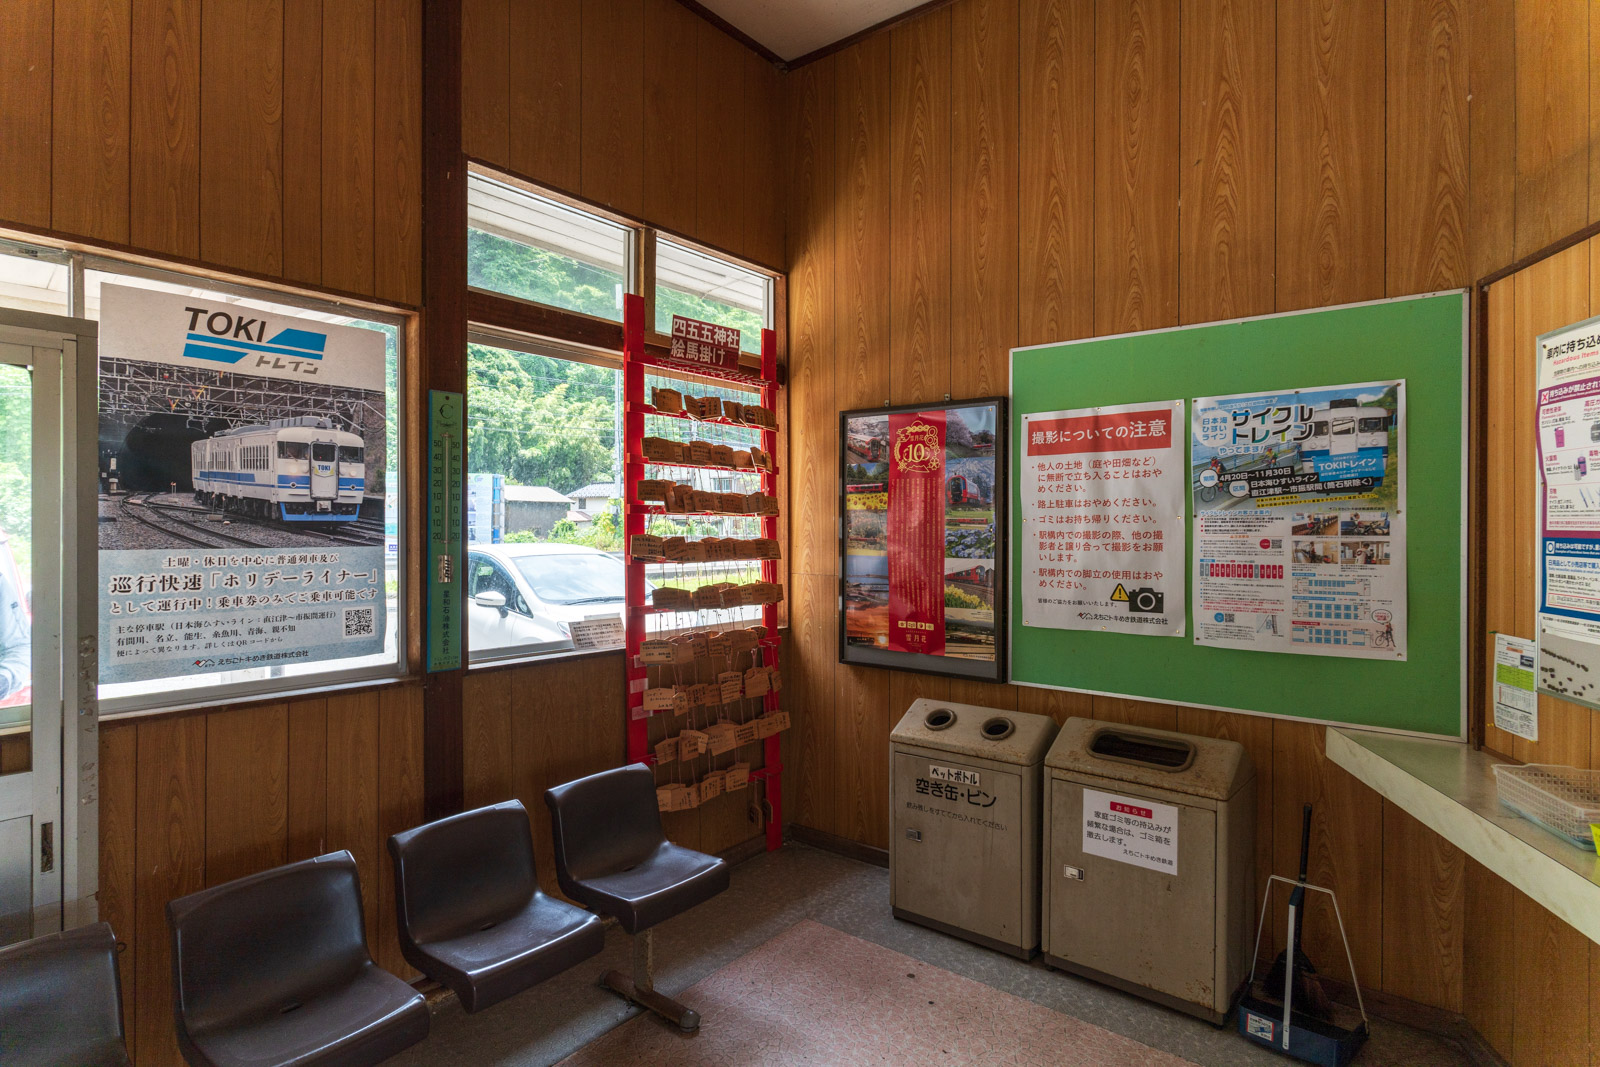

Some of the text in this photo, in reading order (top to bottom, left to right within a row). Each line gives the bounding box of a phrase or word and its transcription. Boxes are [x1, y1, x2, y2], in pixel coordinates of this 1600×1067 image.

[184, 306, 267, 343] TOKI
[672, 318, 739, 349] 四五五神社
[670, 339, 726, 366] 絵馬掛け
[255, 355, 319, 375] トレイン
[1202, 416, 1228, 425] 日本海
[1231, 405, 1314, 428] サイクル
[1031, 418, 1167, 446] 撮影についての注意
[1202, 426, 1228, 434] ひすい
[1202, 433, 1227, 441] ライン
[1232, 424, 1314, 445] トレイン
[433, 453, 442, 461] 40
[907, 443, 925, 463] 10
[433, 466, 460, 475] 30 30
[1318, 458, 1377, 472] TOKIトレイン
[1037, 468, 1163, 482] に無断で立ち入ることはおや
[1220, 467, 1292, 481] 4月20日～11月30日
[1251, 474, 1318, 488] 日本海ひすいライン
[452, 480, 460, 488] 20
[1037, 483, 1088, 493] めください。
[433, 492, 460, 501] 10 10
[433, 519, 442, 527] 10
[433, 532, 460, 540] 20 20
[1039, 542, 1164, 553] 影者と譲り合って撮影をお願
[163, 553, 339, 568] 土曜・休日を中心に普通列車及び
[1039, 553, 1078, 563] いします。
[110, 569, 378, 594] 巡行快速「ホリデーライナー」
[1038, 580, 1088, 591] めください。
[1093, 613, 1169, 626] えちごトキめき鉄道株式会社
[931, 767, 978, 785] ペットボトル
[915, 778, 997, 808] 空き缶・ビン
[1115, 804, 1147, 817] お知らせ
[1094, 810, 1172, 834] 家庭ゴミ等の持込みが
[1086, 830, 1127, 847] 撤去します。
[1122, 848, 1174, 867] えちごトキめき鉄道
